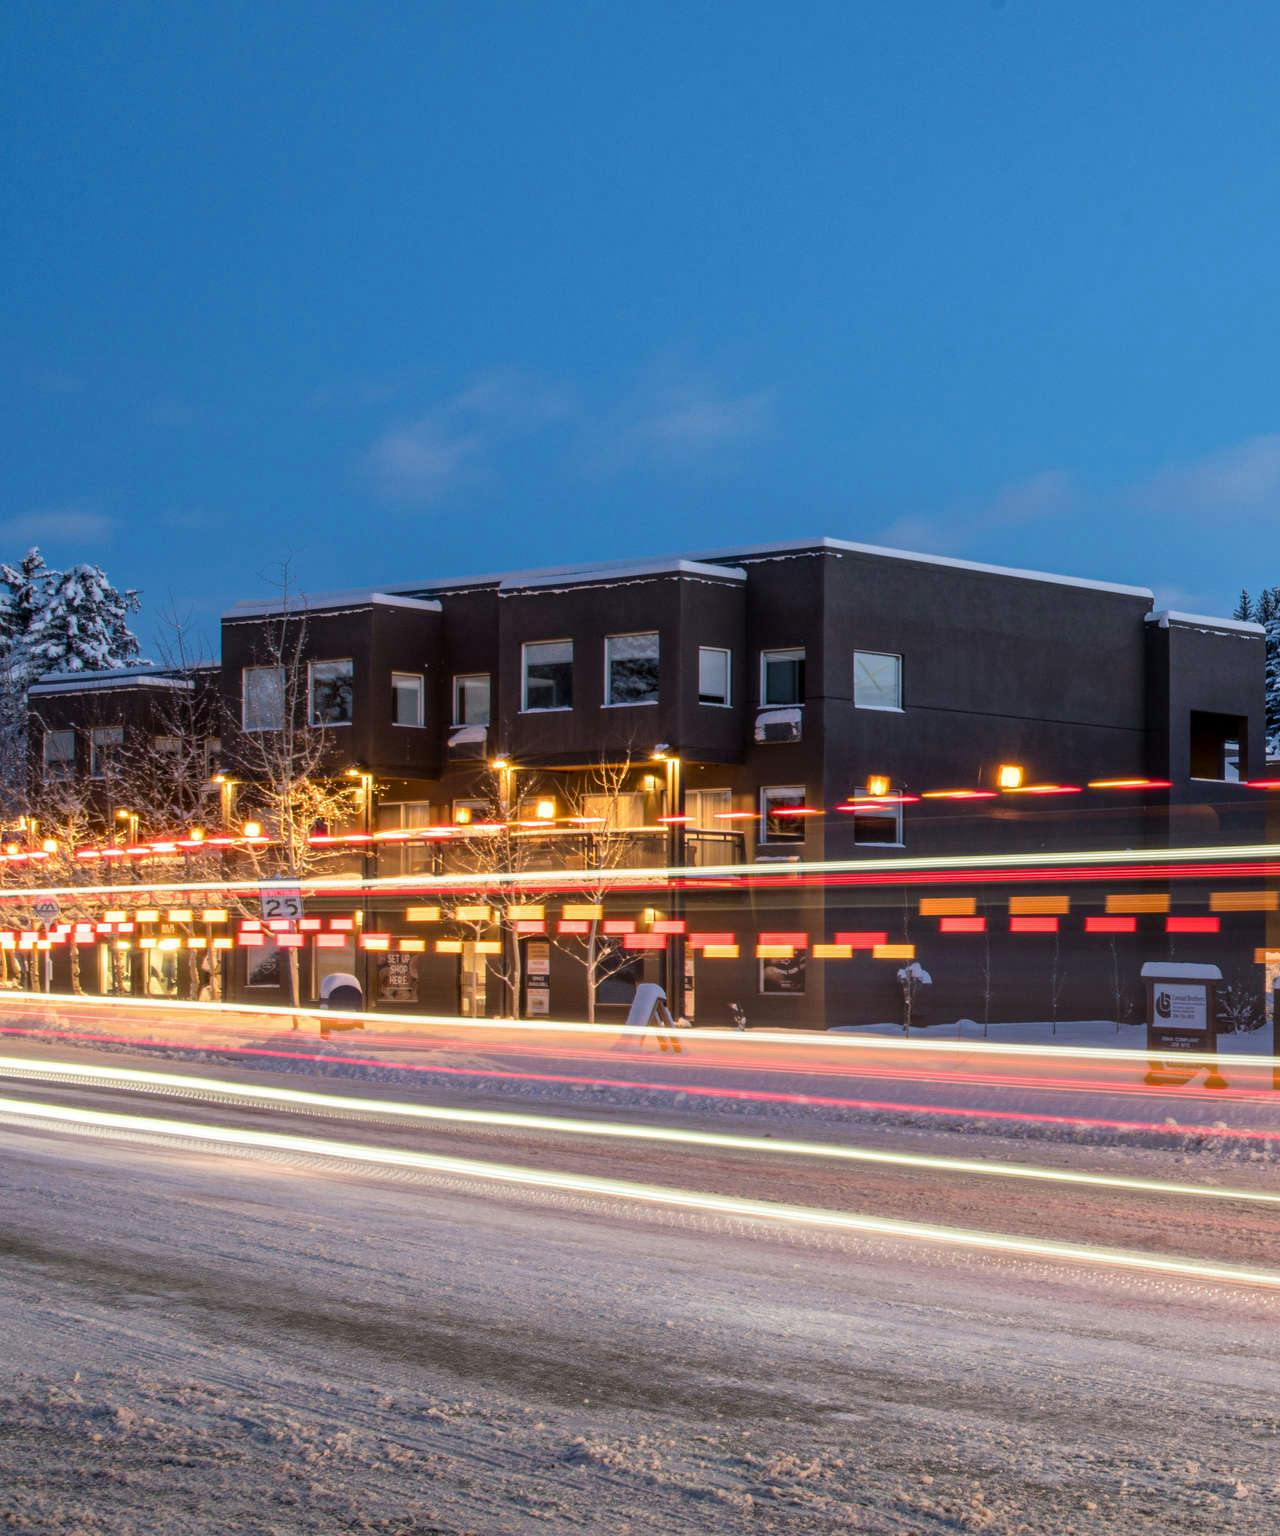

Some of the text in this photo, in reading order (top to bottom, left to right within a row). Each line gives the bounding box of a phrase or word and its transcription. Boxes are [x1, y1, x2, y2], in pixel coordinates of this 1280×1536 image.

[265, 899, 299, 918] 25
[387, 954, 411, 964] SET UP
[390, 964, 409, 974] SHOP
